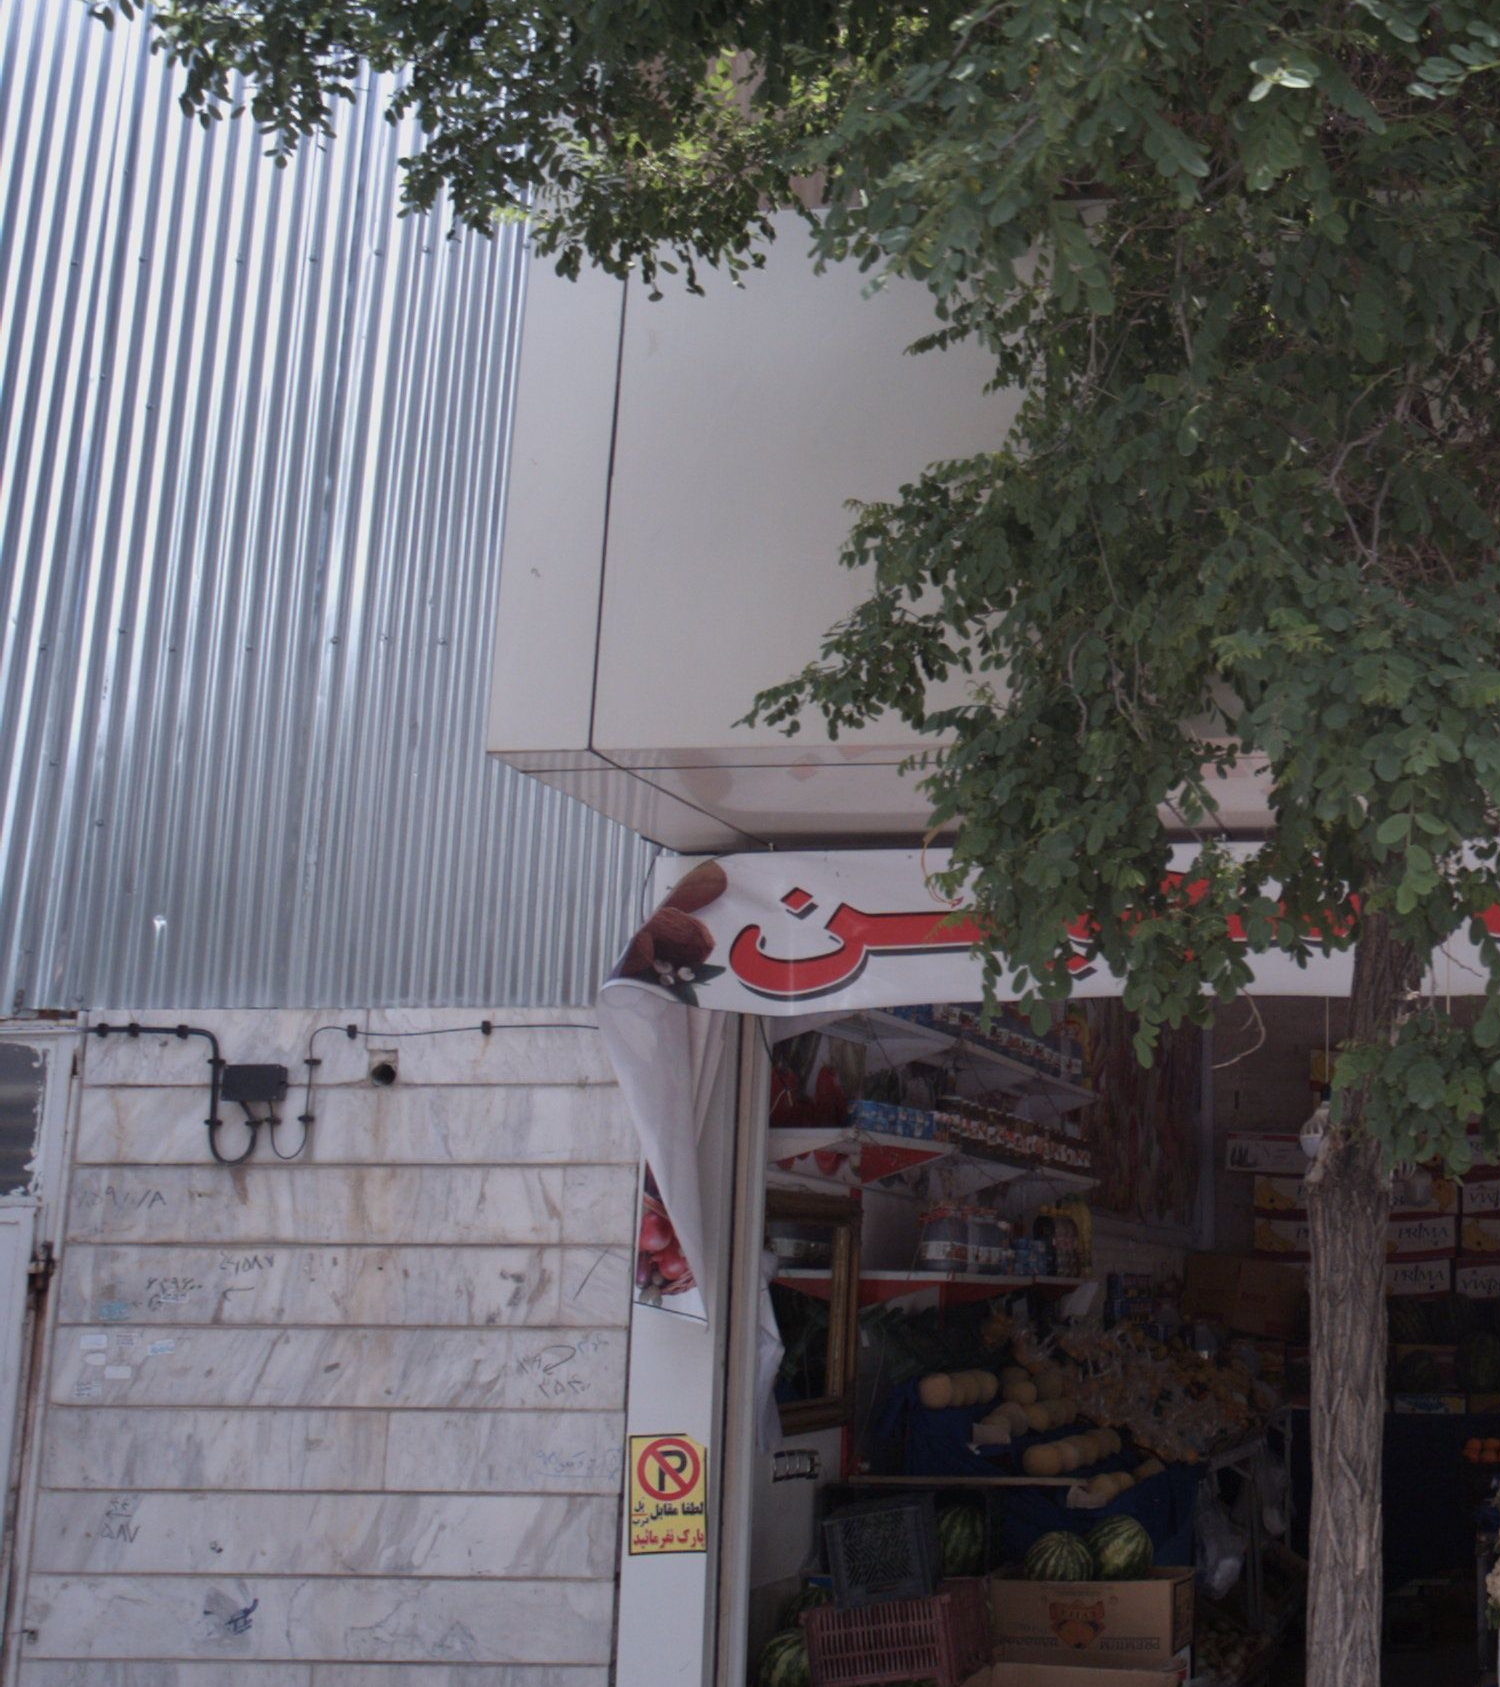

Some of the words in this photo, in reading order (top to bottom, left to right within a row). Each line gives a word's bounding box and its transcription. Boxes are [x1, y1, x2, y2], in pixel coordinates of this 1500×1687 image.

[1398, 1221, 1448, 1240] PRIMA
[1394, 1264, 1445, 1282] PRIMA
[651, 1502, 679, 1520] مقابل
[682, 1502, 704, 1515] لطفا
[677, 1529, 705, 1548] پارک
[1099, 1637, 1161, 1651] PREMIUM
